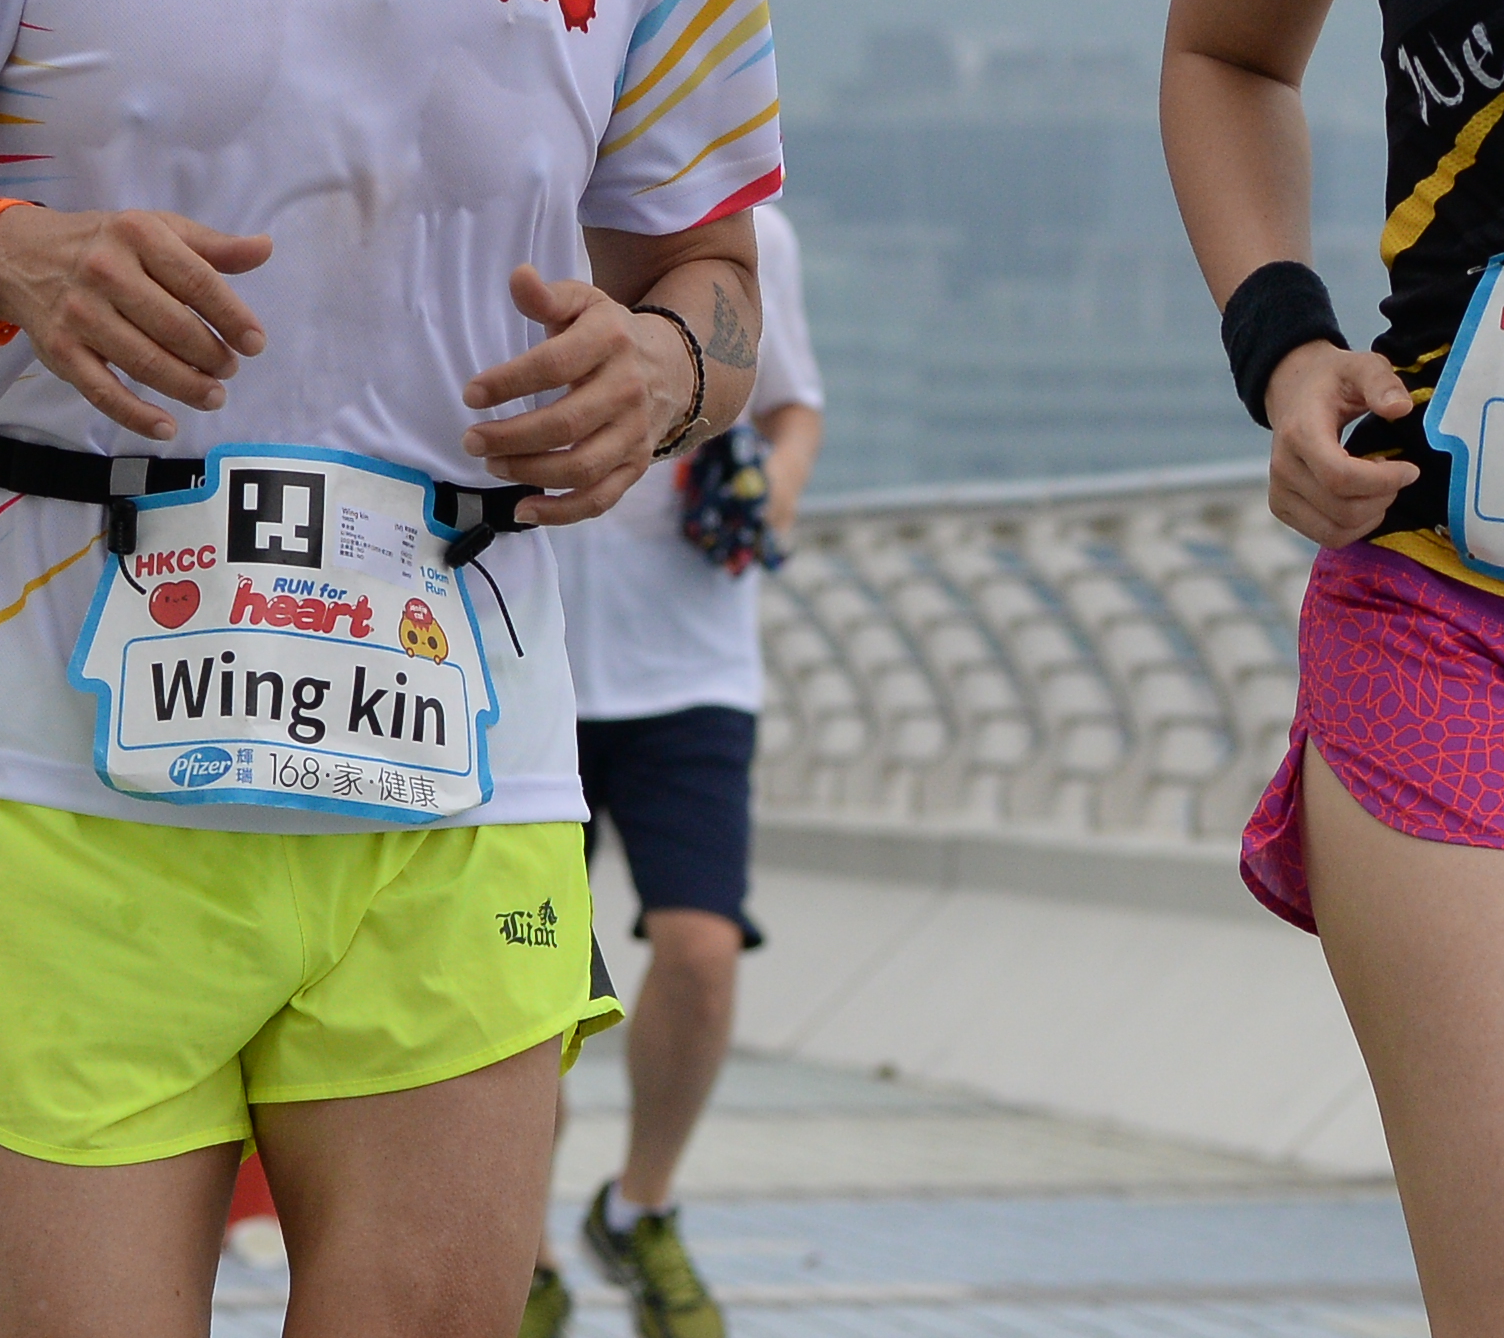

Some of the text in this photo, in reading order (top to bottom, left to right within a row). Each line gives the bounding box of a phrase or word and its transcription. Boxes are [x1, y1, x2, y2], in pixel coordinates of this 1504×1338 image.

[135, 545, 218, 578] HKCC
[420, 565, 450, 584] 10km
[272, 577, 348, 601] RUN for
[425, 581, 447, 597] Run
[229, 575, 374, 638] heart
[151, 650, 447, 747] Wing kin
[173, 750, 232, 785] Pfizer
[495, 911, 558, 949] Lion
